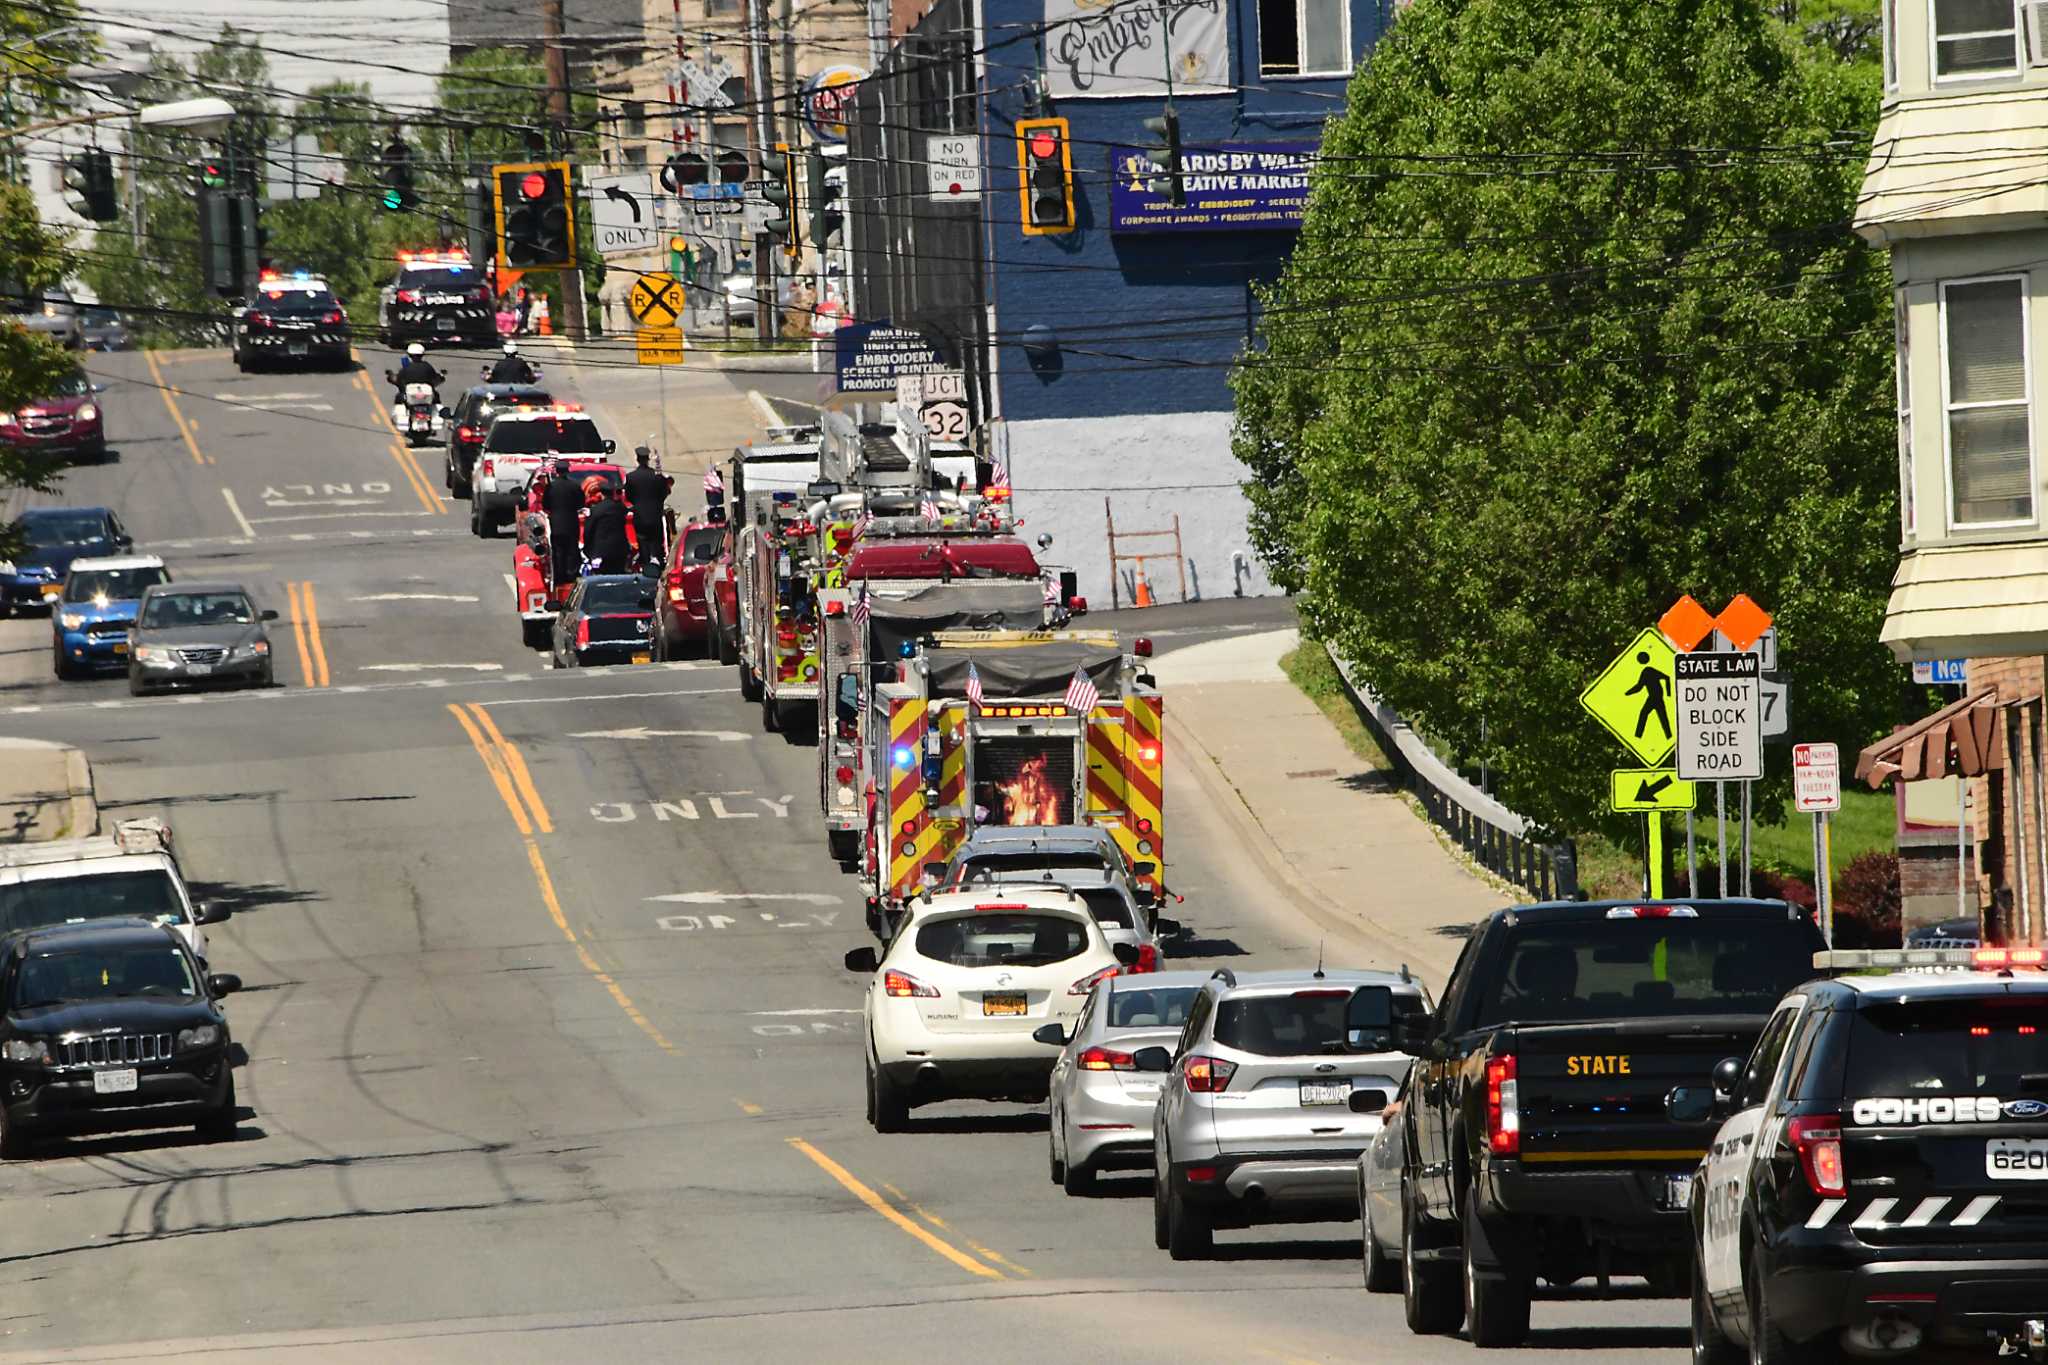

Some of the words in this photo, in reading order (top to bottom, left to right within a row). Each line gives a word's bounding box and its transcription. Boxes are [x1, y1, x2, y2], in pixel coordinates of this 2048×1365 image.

[942, 143, 964, 153] NO
[940, 157, 969, 167] TURN
[1150, 153, 1228, 173] AARDS
[1231, 152, 1254, 170] BY
[1257, 152, 1314, 171] WAL
[934, 169, 949, 181] ON
[955, 168, 975, 180] RED
[1163, 173, 1238, 192] EATIVE
[1241, 172, 1309, 191] MARKET
[1199, 199, 1256, 209] EMBROIDERY
[1268, 197, 1302, 207] SCREEN
[1121, 215, 1171, 225] CORPORATE
[1174, 214, 1210, 223] AWARDS
[1221, 210, 1283, 222] PROMOTIONAL
[604, 228, 649, 245] ONLY
[426, 295, 465, 305] POLICE
[635, 294, 645, 307] R
[669, 291, 680, 304] R
[855, 351, 936, 366] EMBROIDERY
[842, 366, 889, 378] SCREEN
[843, 378, 897, 390] PROMOTIO
[928, 375, 961, 394] JCT
[929, 411, 964, 435] 32
[1678, 659, 1720, 673] STATE
[1726, 658, 1755, 672] LAW
[1685, 687, 1707, 703] DO
[1717, 685, 1750, 701] NOT
[1761, 692, 1778, 721] 7
[1690, 708, 1745, 725] BLOCK
[1699, 731, 1739, 747] SIDE
[1697, 754, 1742, 769] ROAD
[1797, 750, 1809, 764] NO
[589, 794, 795, 823] ONLY
[1567, 1055, 1631, 1075] STATE
[1852, 1097, 2000, 1125] COHOES
[2014, 1102, 2040, 1113] Ford
[1994, 1150, 2048, 1169] 620
